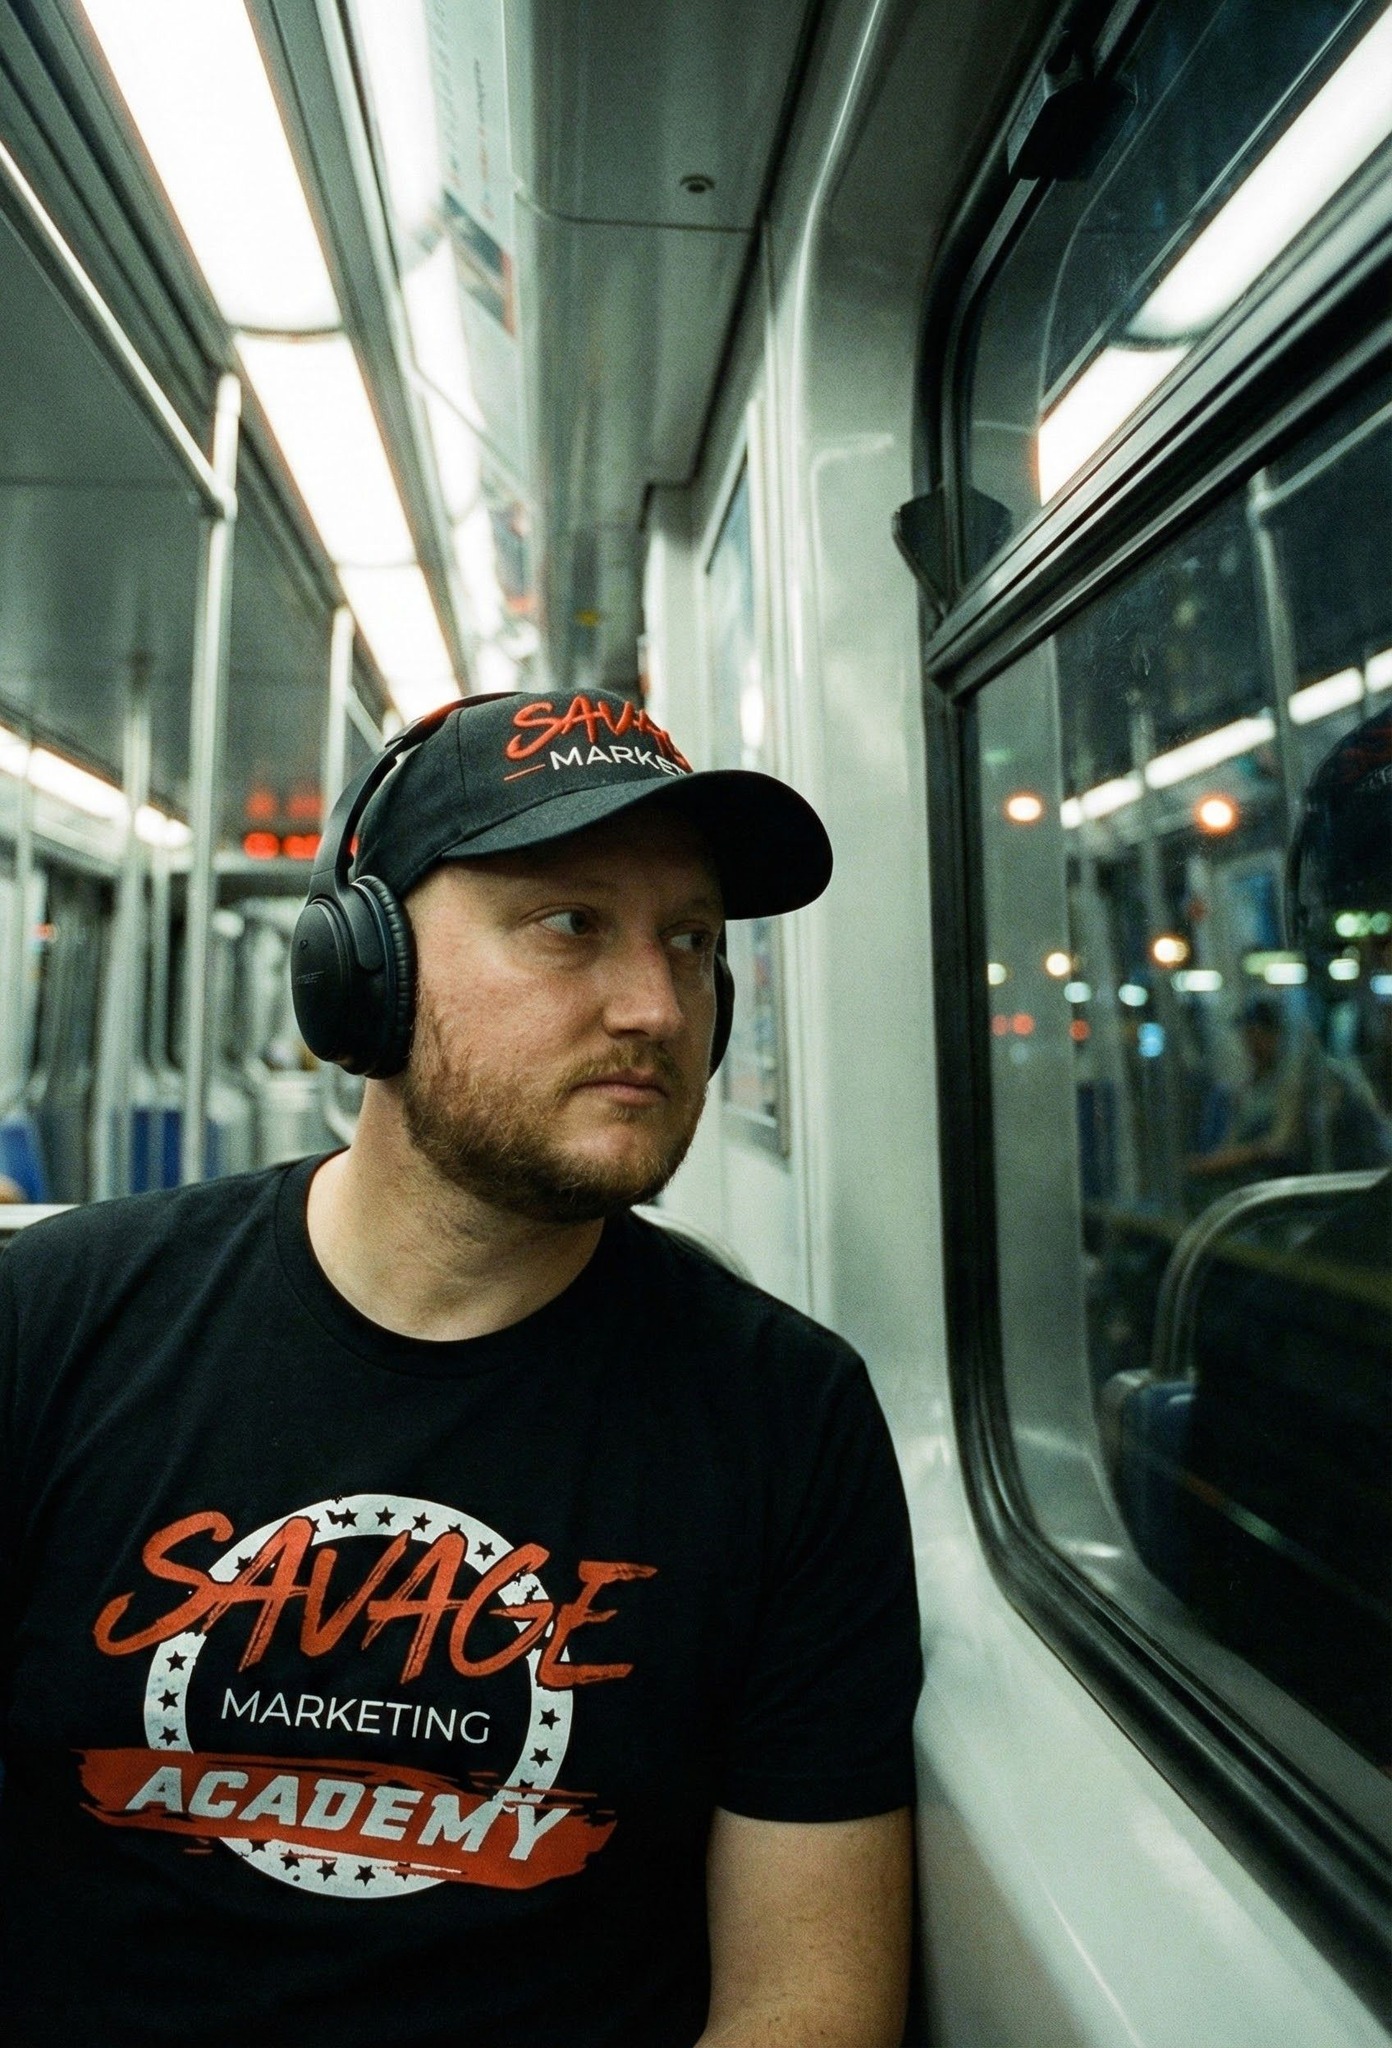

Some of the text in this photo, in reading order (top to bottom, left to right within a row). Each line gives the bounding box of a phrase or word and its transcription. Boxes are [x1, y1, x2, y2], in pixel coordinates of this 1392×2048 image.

[94, 1511, 658, 1687] SAVAGE
[220, 1688, 491, 1744] MARKETING
[126, 1765, 571, 1861] ACADEMY
